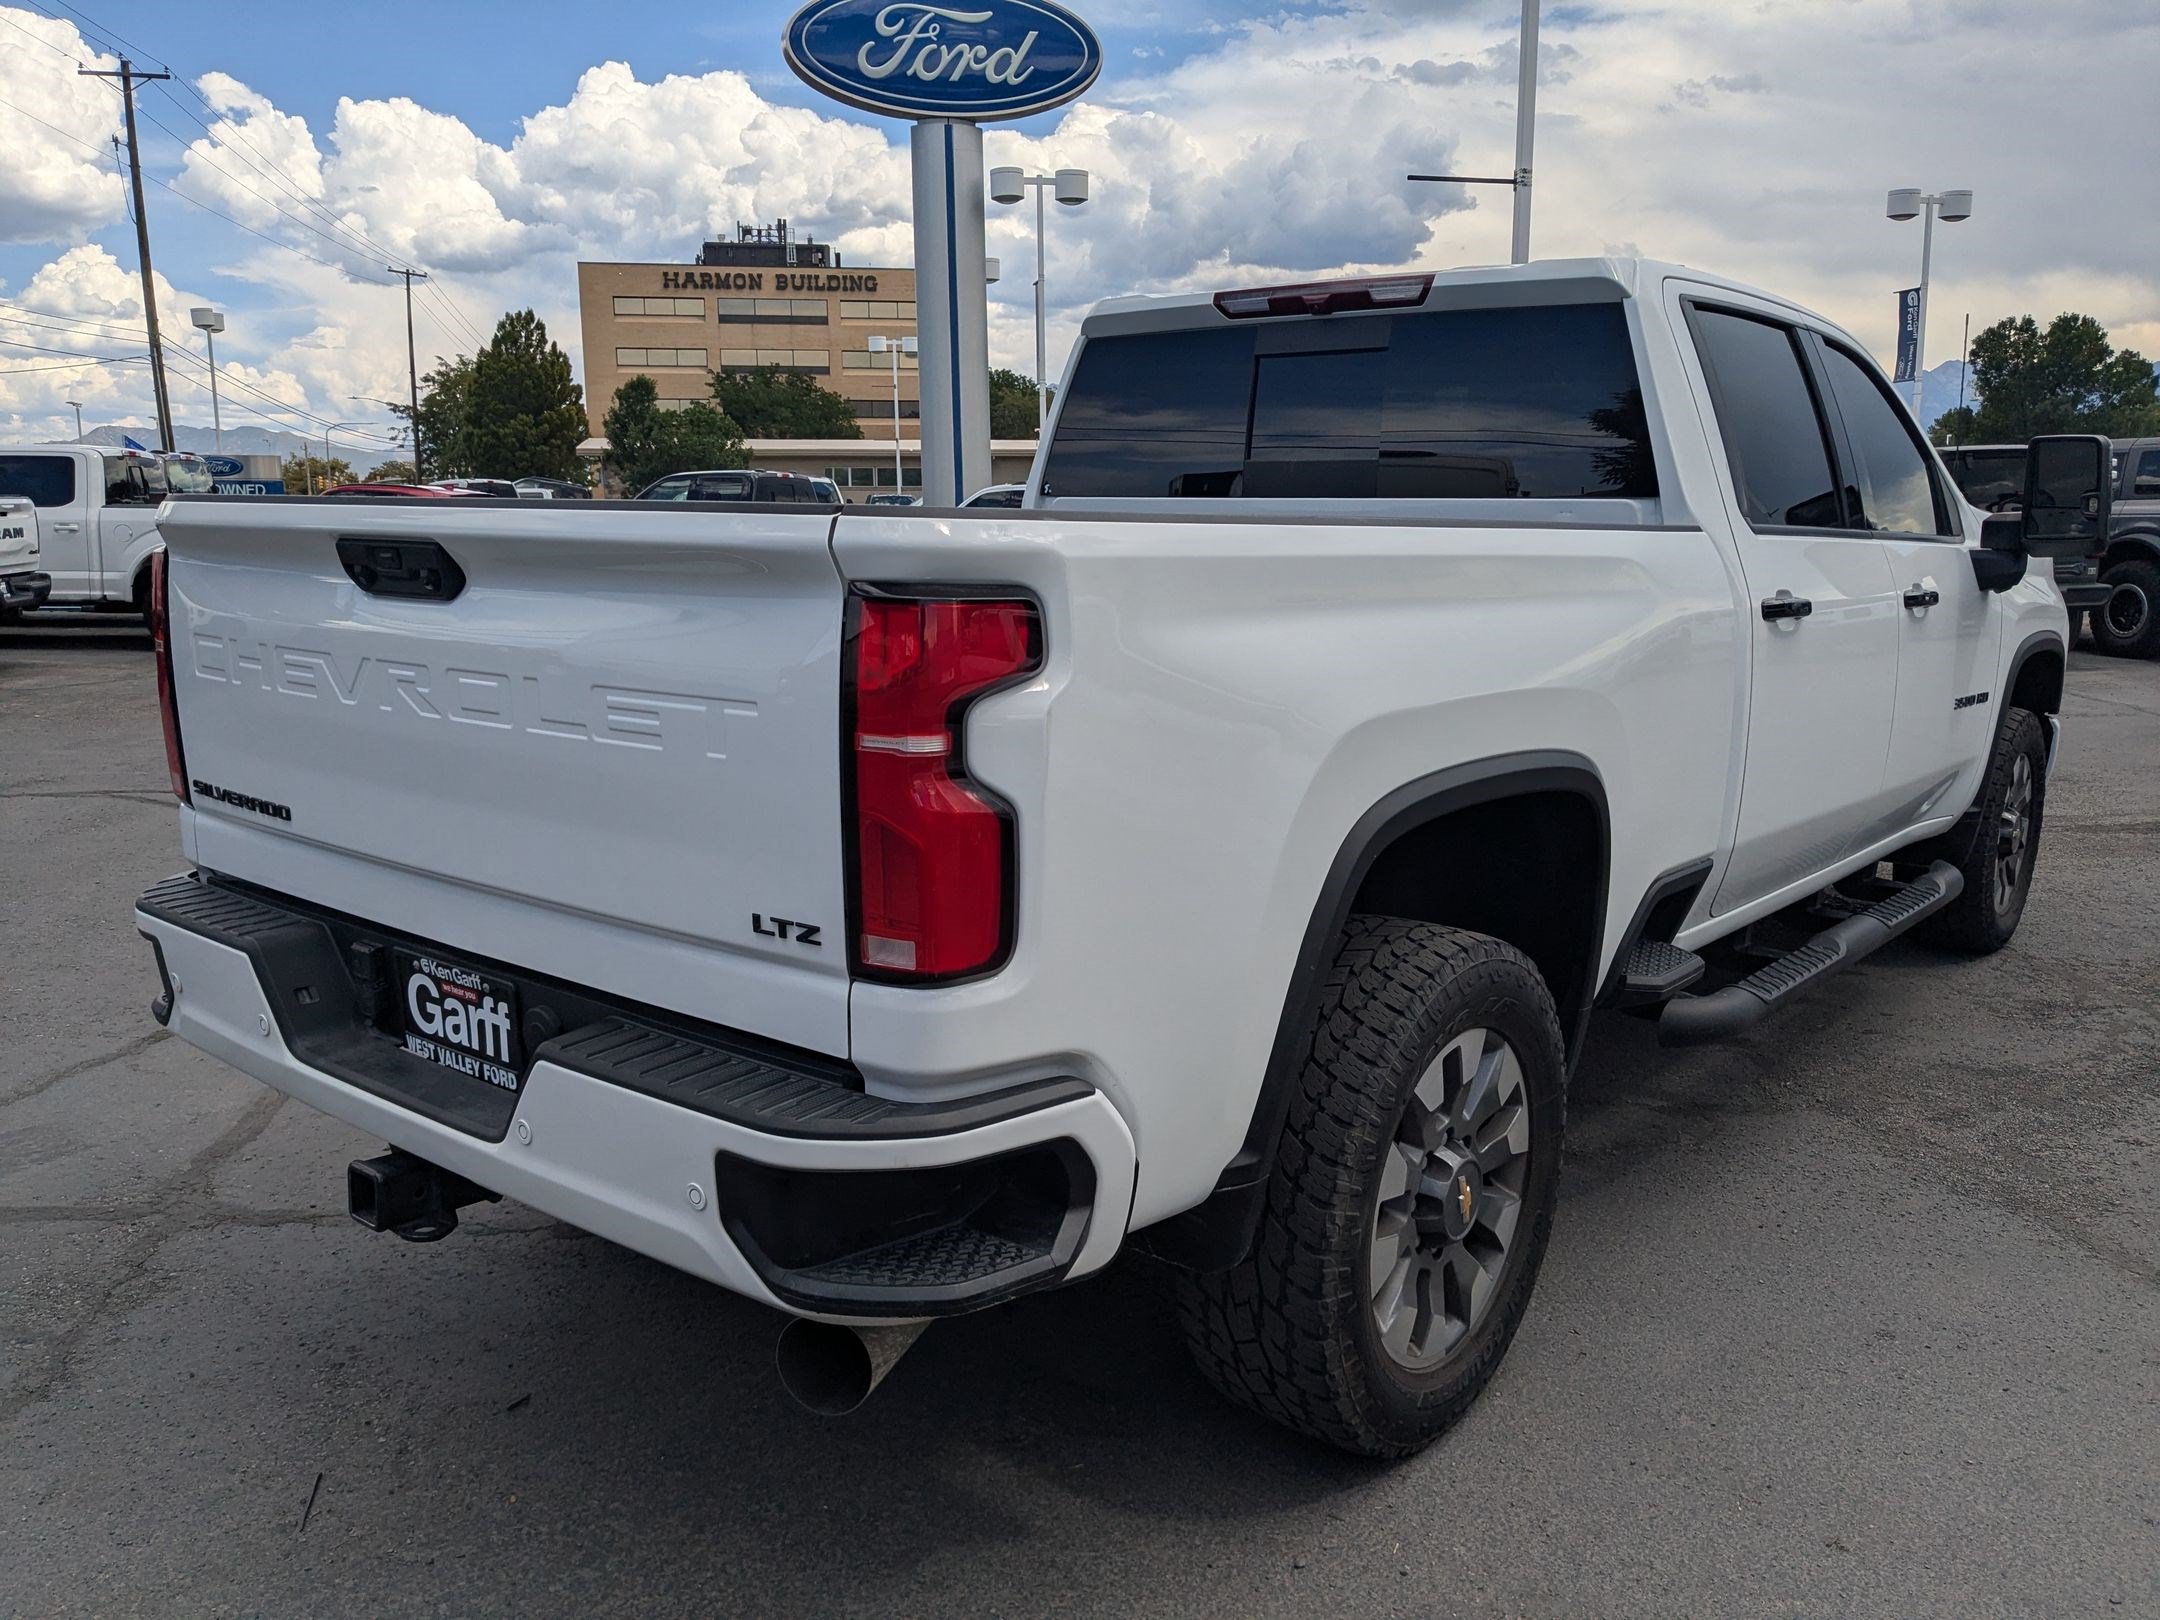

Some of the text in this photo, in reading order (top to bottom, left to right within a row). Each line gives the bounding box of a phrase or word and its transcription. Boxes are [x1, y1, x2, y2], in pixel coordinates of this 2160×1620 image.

[857, 3, 1039, 86] Ford
[662, 271, 878, 292] HARMON BUILDING
[0, 527, 24, 539] AM
[193, 632, 759, 759] CHEVROLET
[192, 779, 292, 822] SILVERADO
[752, 912, 822, 946] LTZ
[407, 973, 511, 1063] Garff
[406, 1034, 518, 1090] WEST VALLEY FORD
